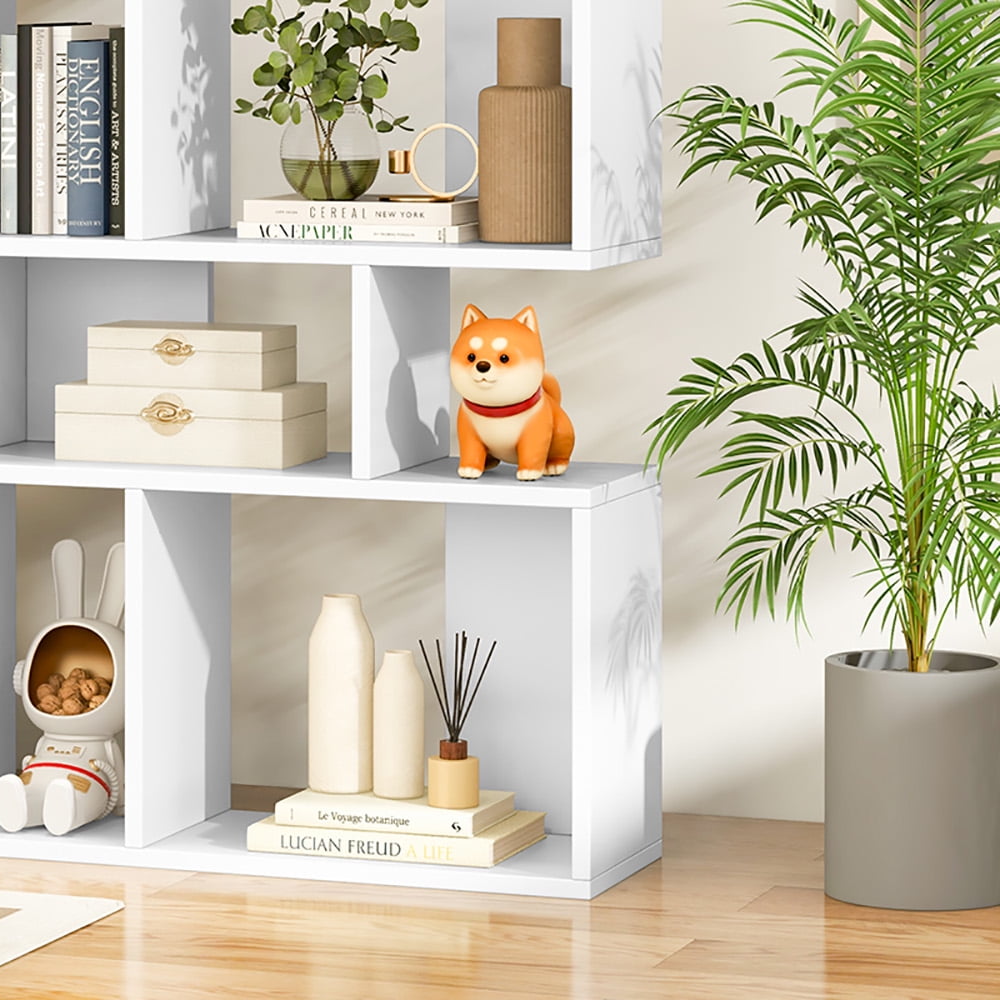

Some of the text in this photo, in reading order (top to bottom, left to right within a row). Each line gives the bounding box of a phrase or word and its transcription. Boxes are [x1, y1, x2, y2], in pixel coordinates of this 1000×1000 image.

[34, 29, 45, 197] Moving Norman Foster on Art
[68, 58, 80, 186] DICTIONARY
[80, 57, 101, 185] ENGLISH
[111, 110, 120, 137] ART
[111, 139, 120, 150] &
[56, 142, 67, 195] TREES
[111, 152, 120, 206] ARTISTS
[309, 206, 367, 220] CEREAL
[375, 210, 425, 219] NEW YORK
[318, 811, 410, 827] Le Voyage botanique
[280, 834, 453, 861] LUCIAN FREUD A LIFE
